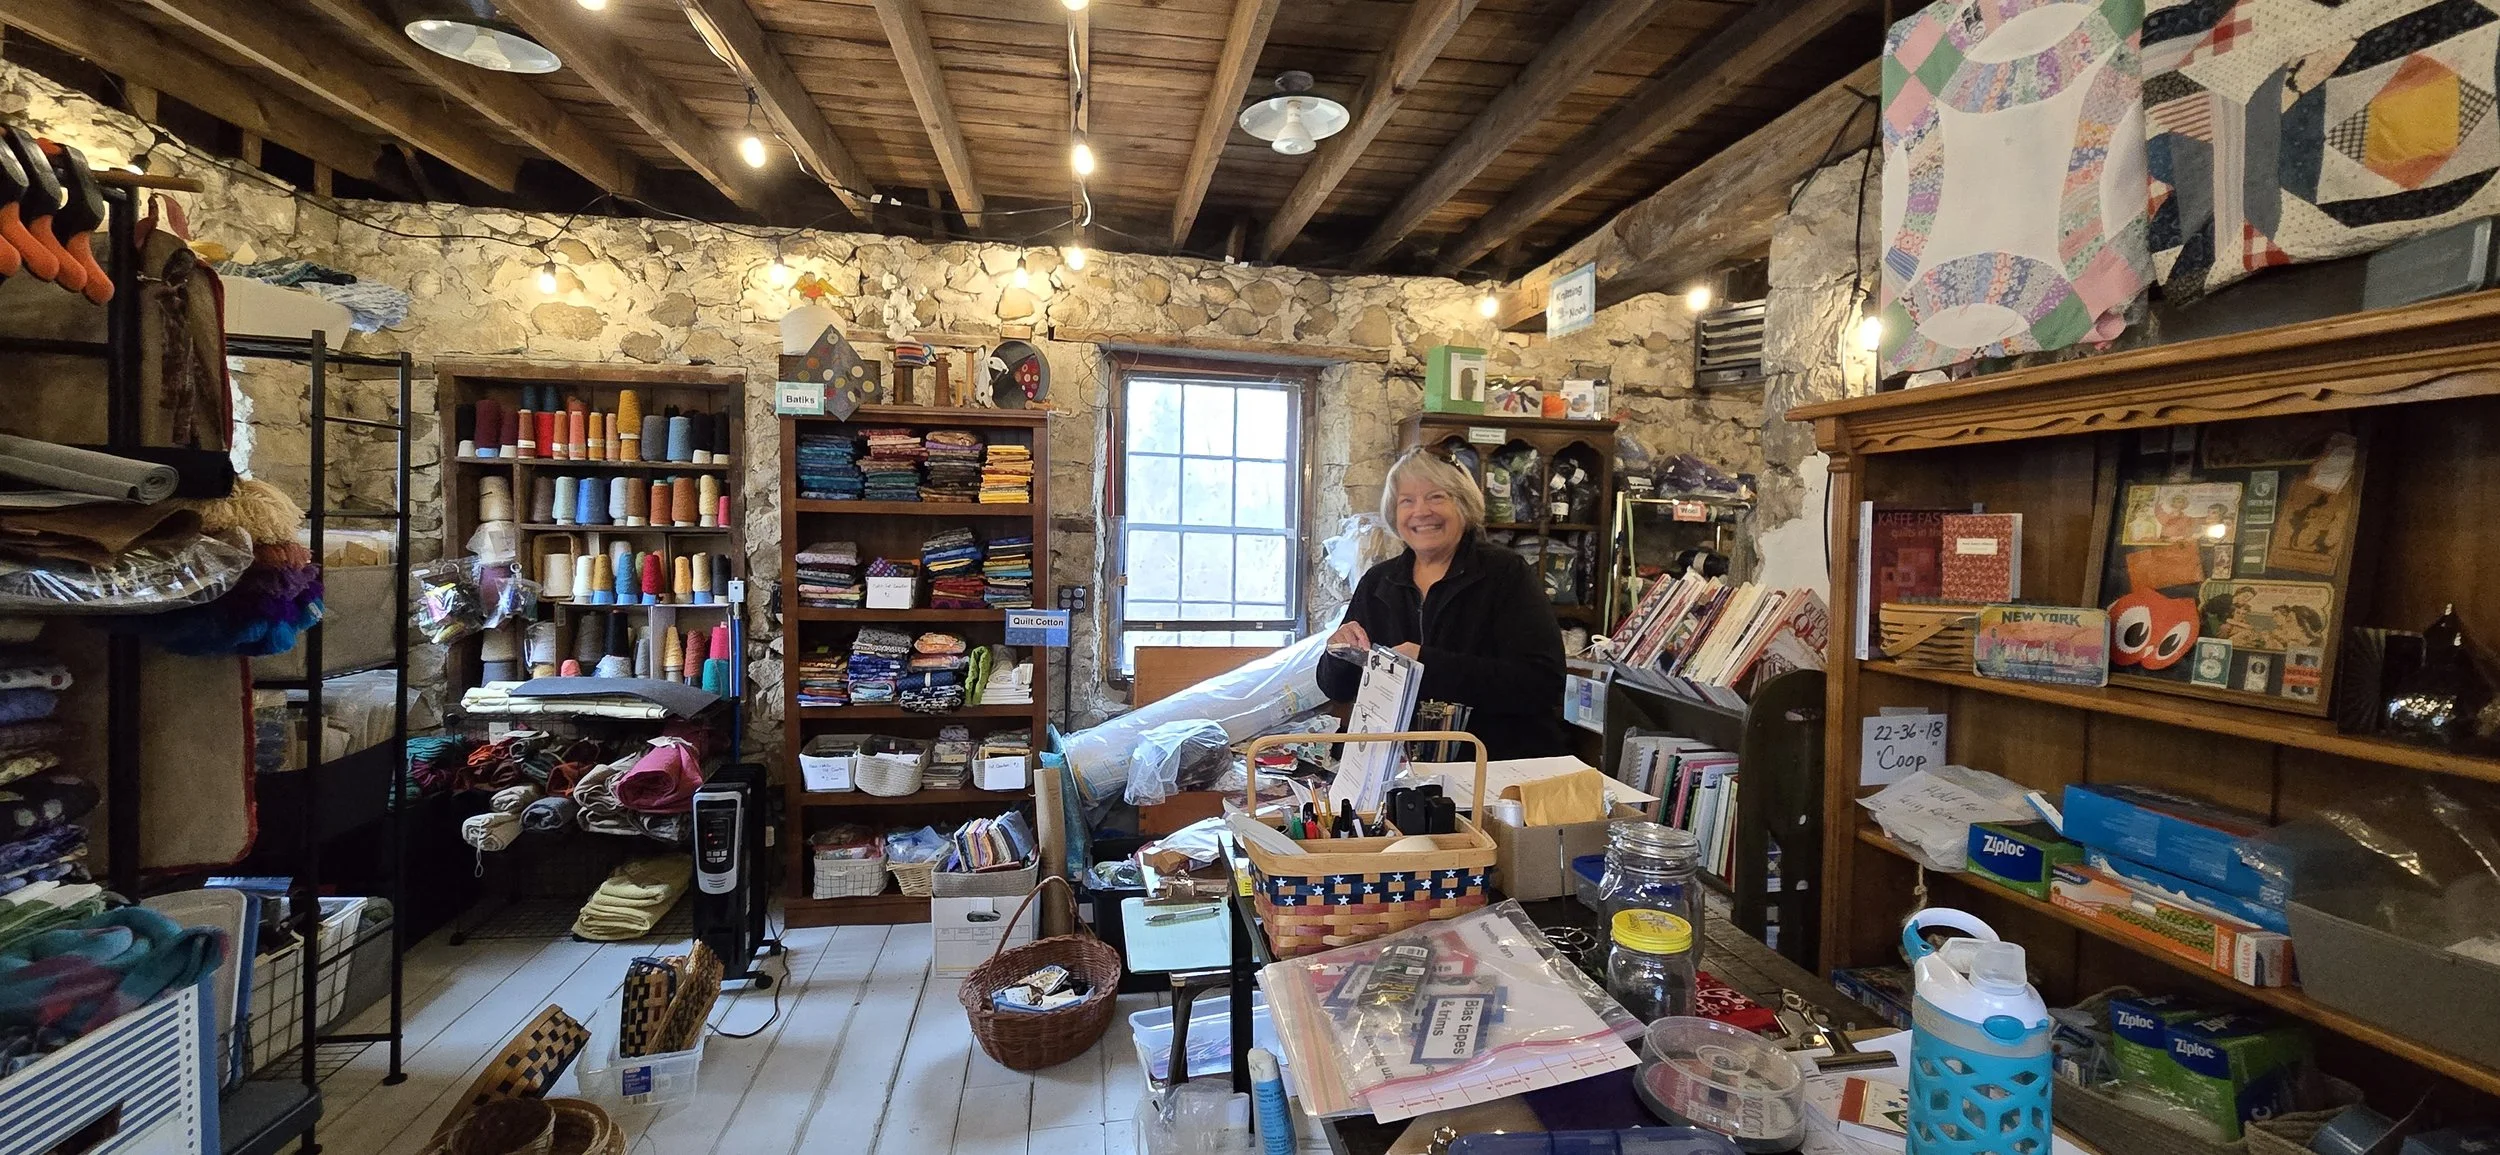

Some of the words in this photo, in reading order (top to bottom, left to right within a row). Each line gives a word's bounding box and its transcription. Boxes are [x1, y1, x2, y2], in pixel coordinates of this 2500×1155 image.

[1569, 303, 1587, 318] Nook
[786, 395, 815, 404] Batiks
[1877, 512, 1916, 527] KAFFE
[1013, 617, 1033, 625] Quilt
[1036, 617, 1064, 626] Cotton
[2001, 610, 2036, 625] NEW
[2039, 611, 2082, 627] YORK
[1873, 721, 1944, 741] 22-36-18
[1982, 834, 2026, 857] Ziploc
[2065, 899, 2099, 919] ZIPPER
[1440, 1000, 1453, 1009] &
[1460, 1000, 1480, 1025] Bias
[1432, 1008, 1451, 1037] trims
[2117, 1010, 2155, 1030] Ziploc
[1453, 1025, 1473, 1056] tapes
[2174, 1037, 2216, 1059] Ziploc
